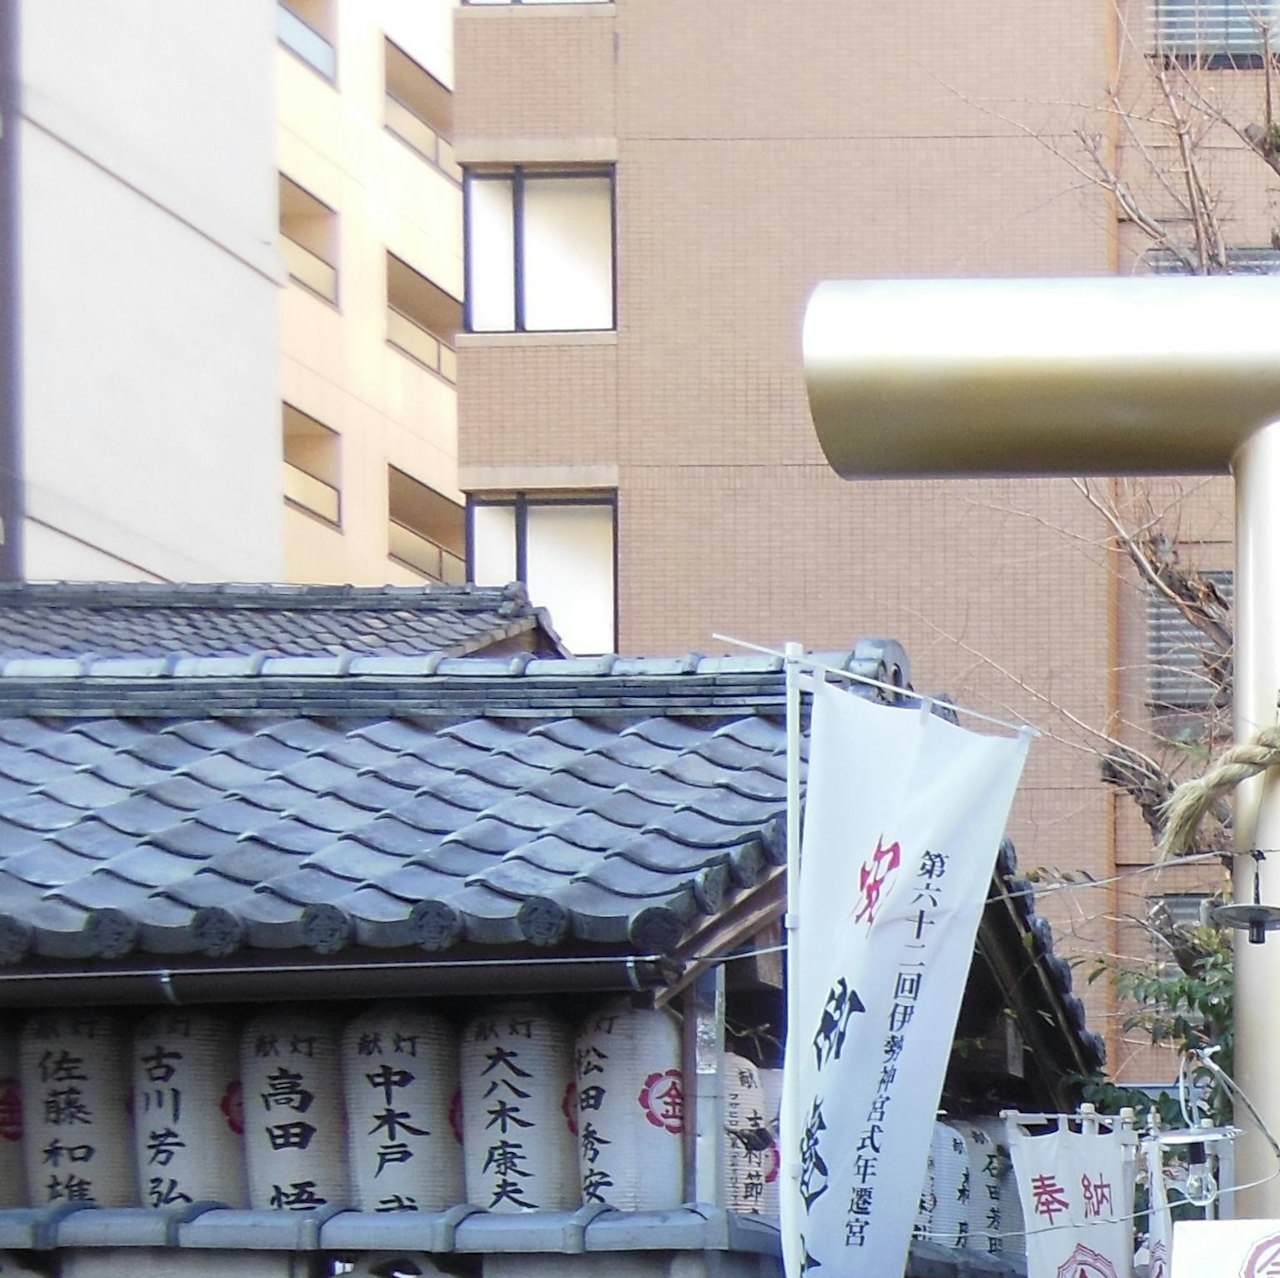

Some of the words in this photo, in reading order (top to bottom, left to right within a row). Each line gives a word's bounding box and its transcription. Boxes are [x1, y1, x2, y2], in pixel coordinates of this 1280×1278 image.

[255, 1033, 318, 1058] 献灯
[358, 1033, 419, 1058] 献灯
[845, 850, 950, 1247] 第六十二回伊勢神宮式年遷宮
[142, 1046, 193, 1208] 古川芳弘
[481, 1046, 541, 1209] 大八木康夫
[576, 1048, 616, 1204] 松田秀安
[1031, 1172, 1114, 1226] 奉納
